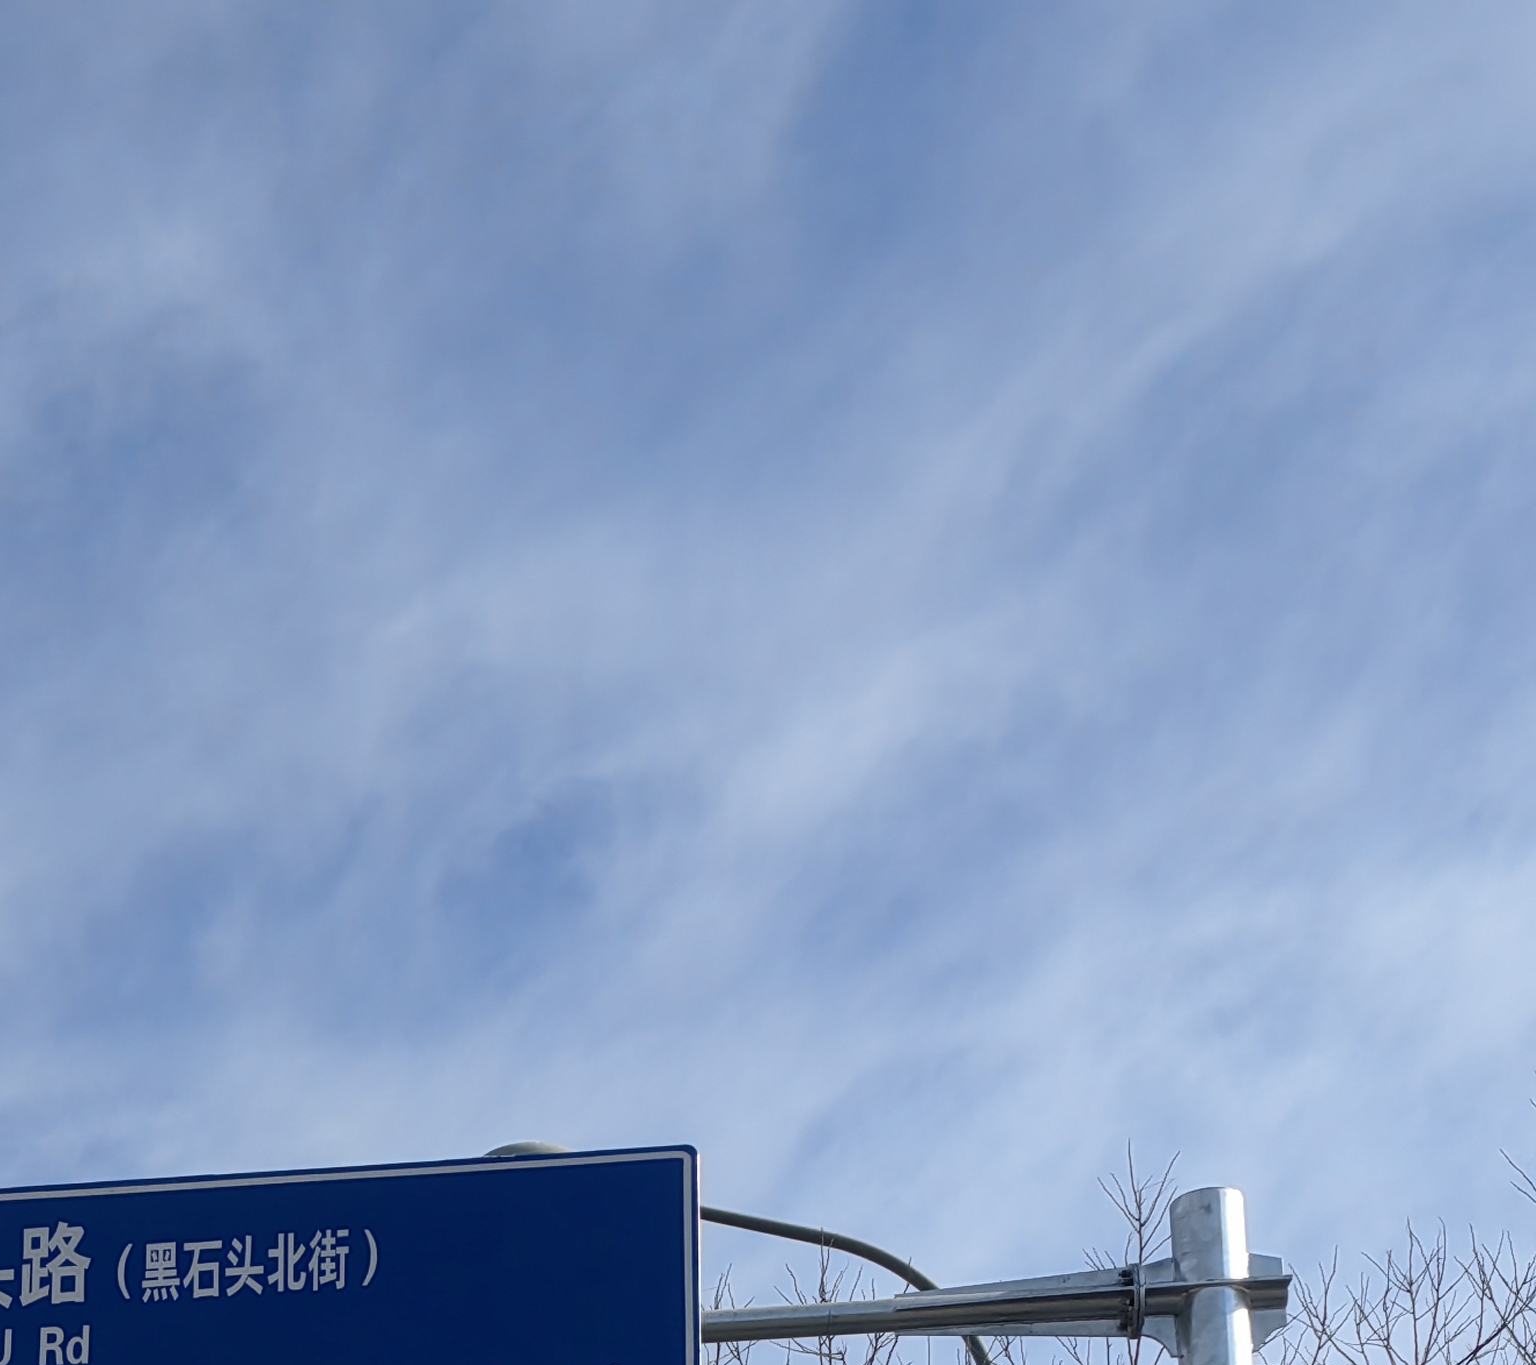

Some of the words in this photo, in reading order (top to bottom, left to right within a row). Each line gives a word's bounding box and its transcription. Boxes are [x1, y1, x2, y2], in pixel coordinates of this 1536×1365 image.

[118, 1230, 377, 1302] (黑石头北街)
[38, 1325, 90, 1365] Rd
